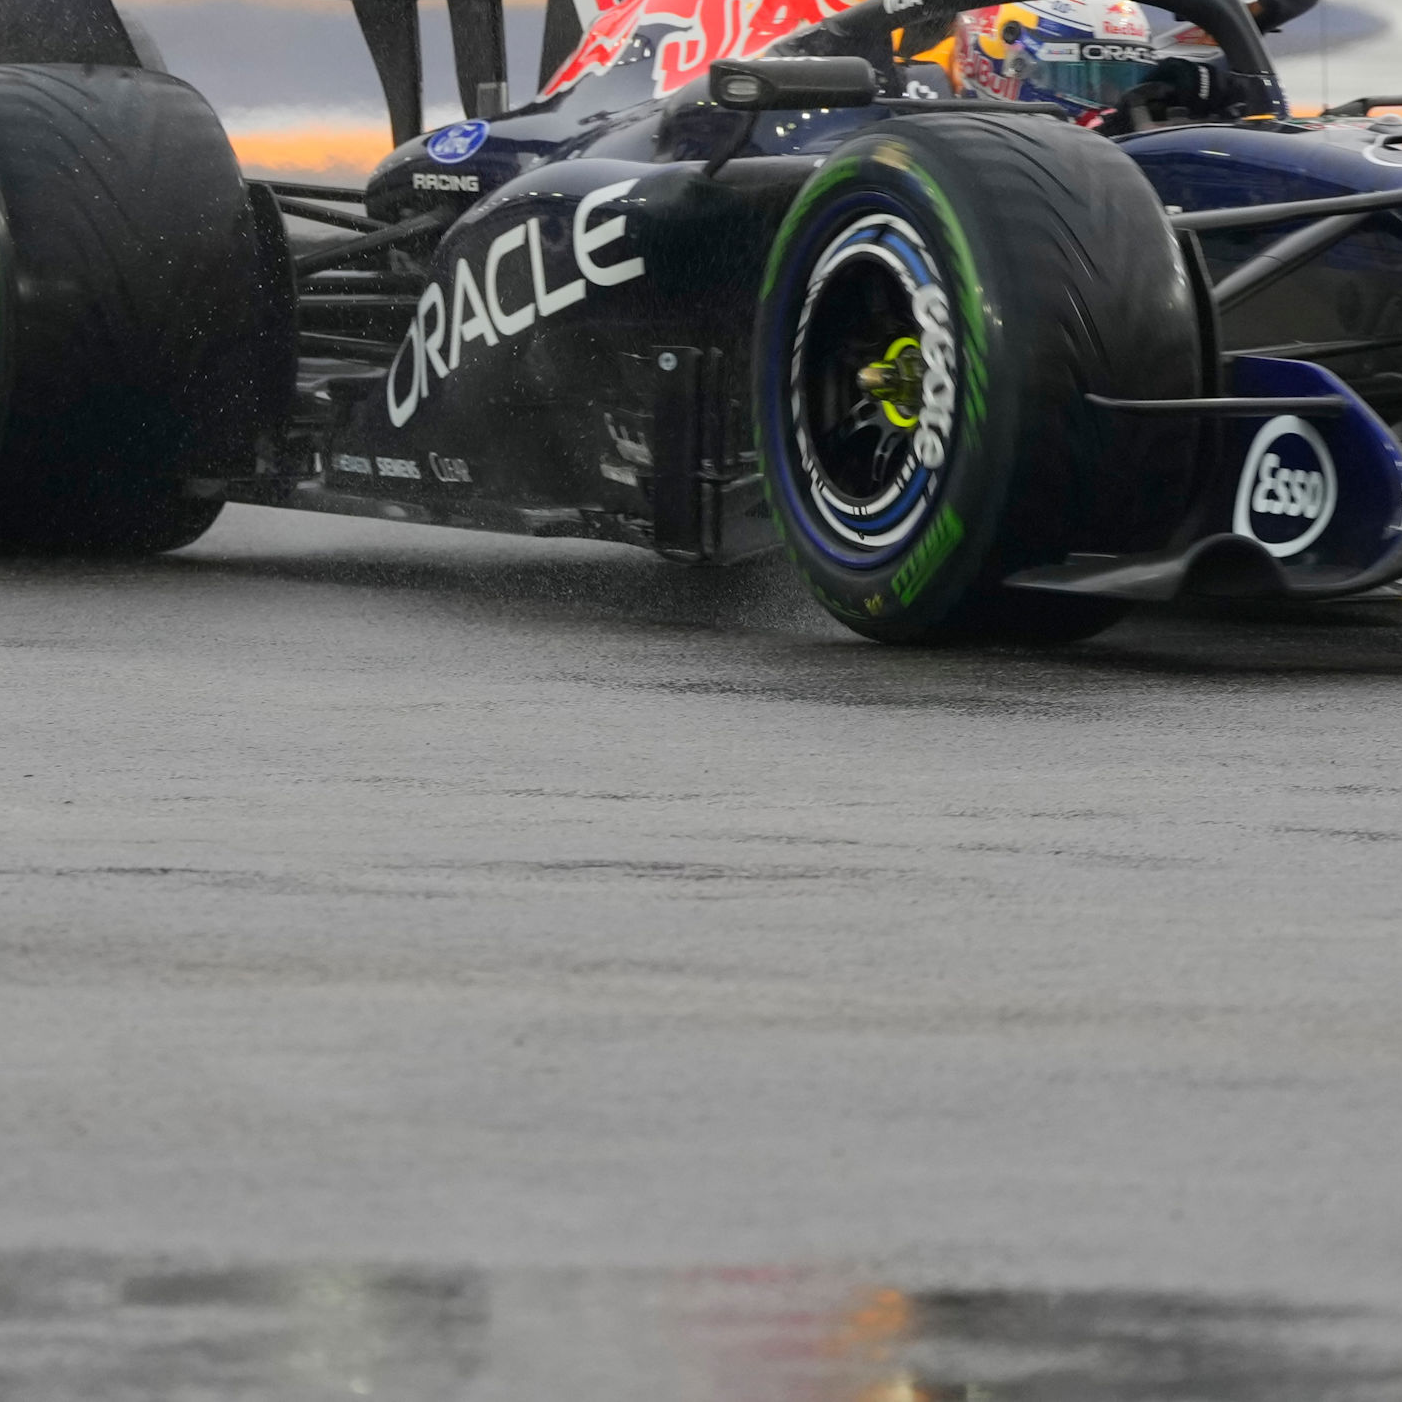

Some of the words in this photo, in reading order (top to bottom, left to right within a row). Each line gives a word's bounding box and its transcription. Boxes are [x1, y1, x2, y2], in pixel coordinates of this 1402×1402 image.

[412, 173, 480, 192] RACING
[387, 178, 646, 428] ORACLE
[1251, 452, 1325, 520] Esso
